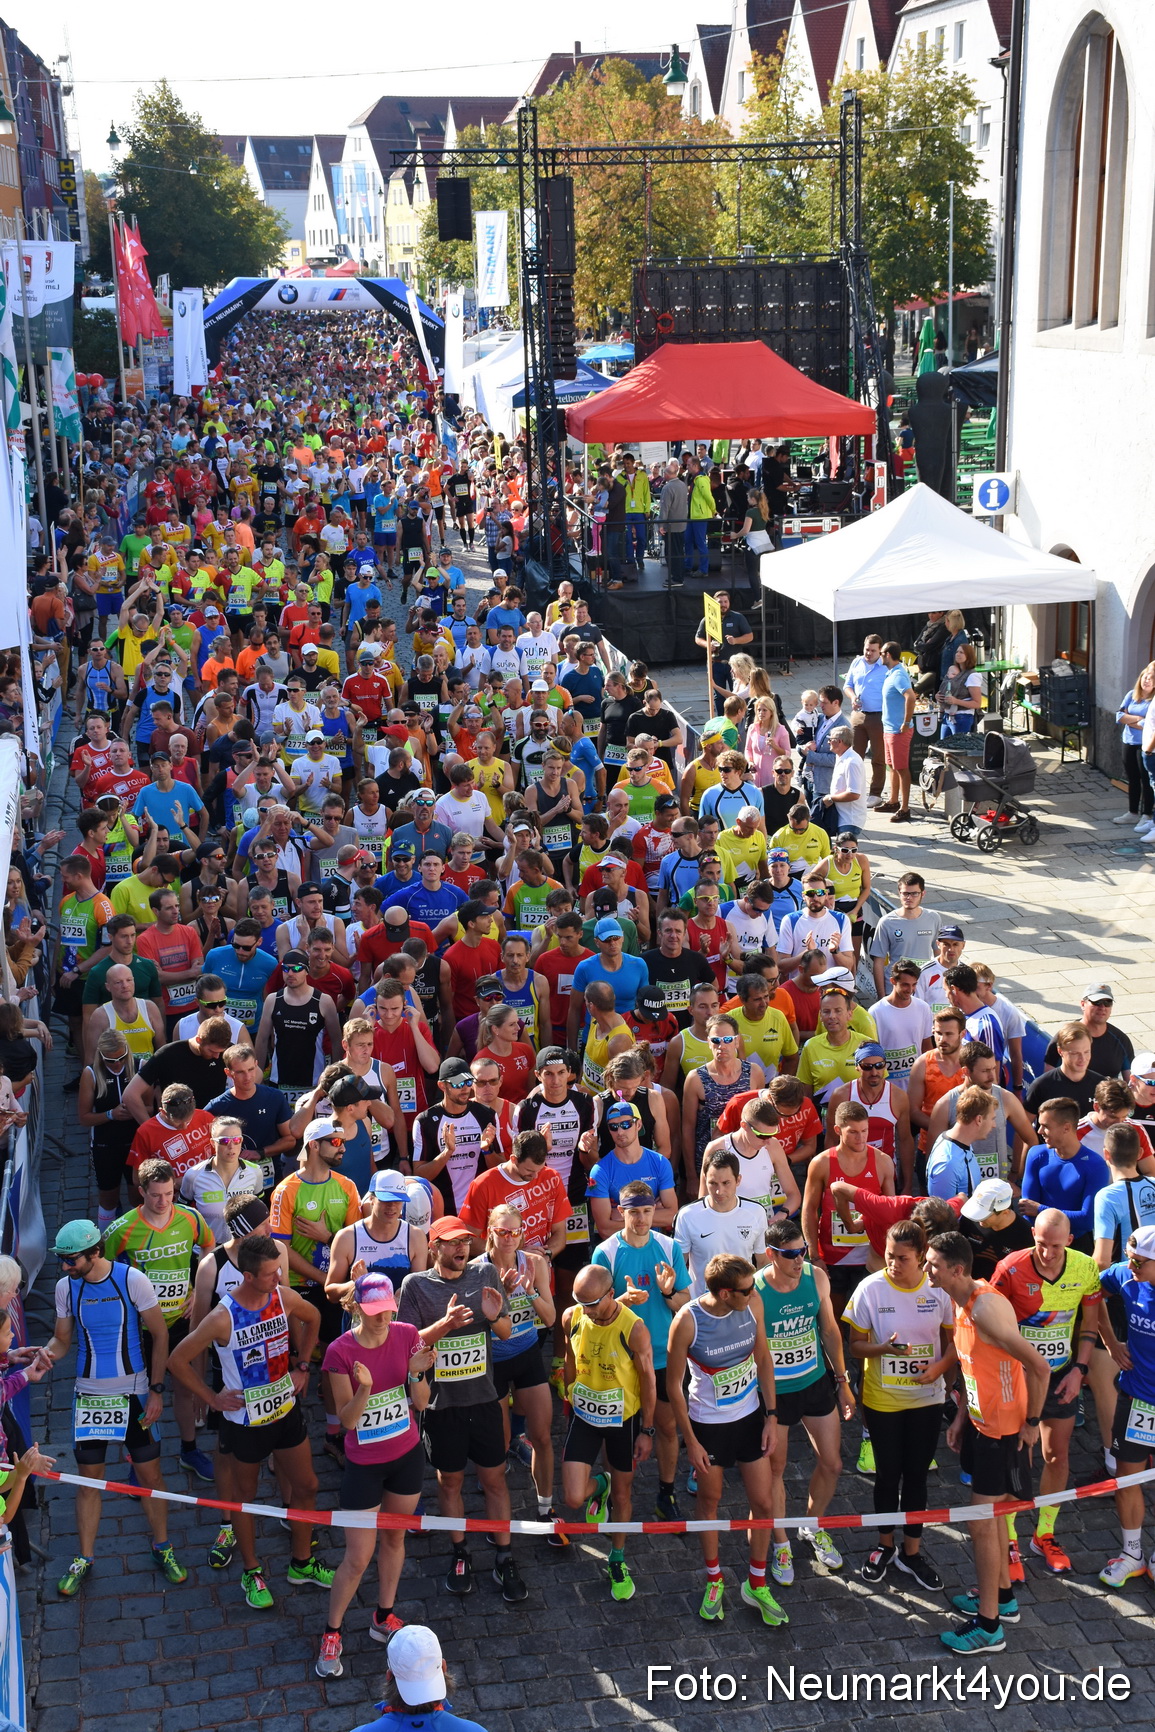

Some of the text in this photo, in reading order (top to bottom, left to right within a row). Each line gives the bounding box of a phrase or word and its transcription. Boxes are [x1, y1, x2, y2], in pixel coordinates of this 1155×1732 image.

[59, 160, 81, 238] HOTE
[607, 753, 626, 762] 2792
[547, 834, 568, 844] 2156
[360, 842, 382, 853] 2183
[106, 863, 129, 874] 2686
[419, 907, 450, 917] SYSCAD
[525, 915, 550, 925] 1279
[61, 925, 84, 937] 2729
[172, 984, 196, 998] 2042
[666, 991, 690, 1001] 331
[887, 1058, 914, 1073] 2249
[206, 1193, 220, 1201] CIS
[136, 1241, 188, 1263] BOCK
[149, 1272, 188, 1284] BOCK
[235, 1315, 287, 1345] LA CARRERA
[772, 1315, 815, 1337] TWin
[237, 1332, 264, 1348] TRITEAM
[1023, 1328, 1067, 1342] BOCK
[439, 1335, 483, 1351] BOCK
[770, 1334, 816, 1354] BOCK
[441, 1350, 481, 1368] 1072
[774, 1349, 813, 1370] 2835
[440, 1365, 482, 1378] CHRISTIAN
[715, 1361, 754, 1385] BOCK
[248, 1378, 292, 1400] BOCK
[721, 1371, 755, 1398] 2741
[576, 1385, 620, 1402] BOCK
[85, 1397, 125, 1409] BOCK
[577, 1397, 618, 1417] 2062
[81, 1410, 123, 1425] 2628
[361, 1403, 404, 1430] 2742
[577, 1412, 613, 1425] JÜRGEN
[88, 1427, 116, 1437] ARMIN
